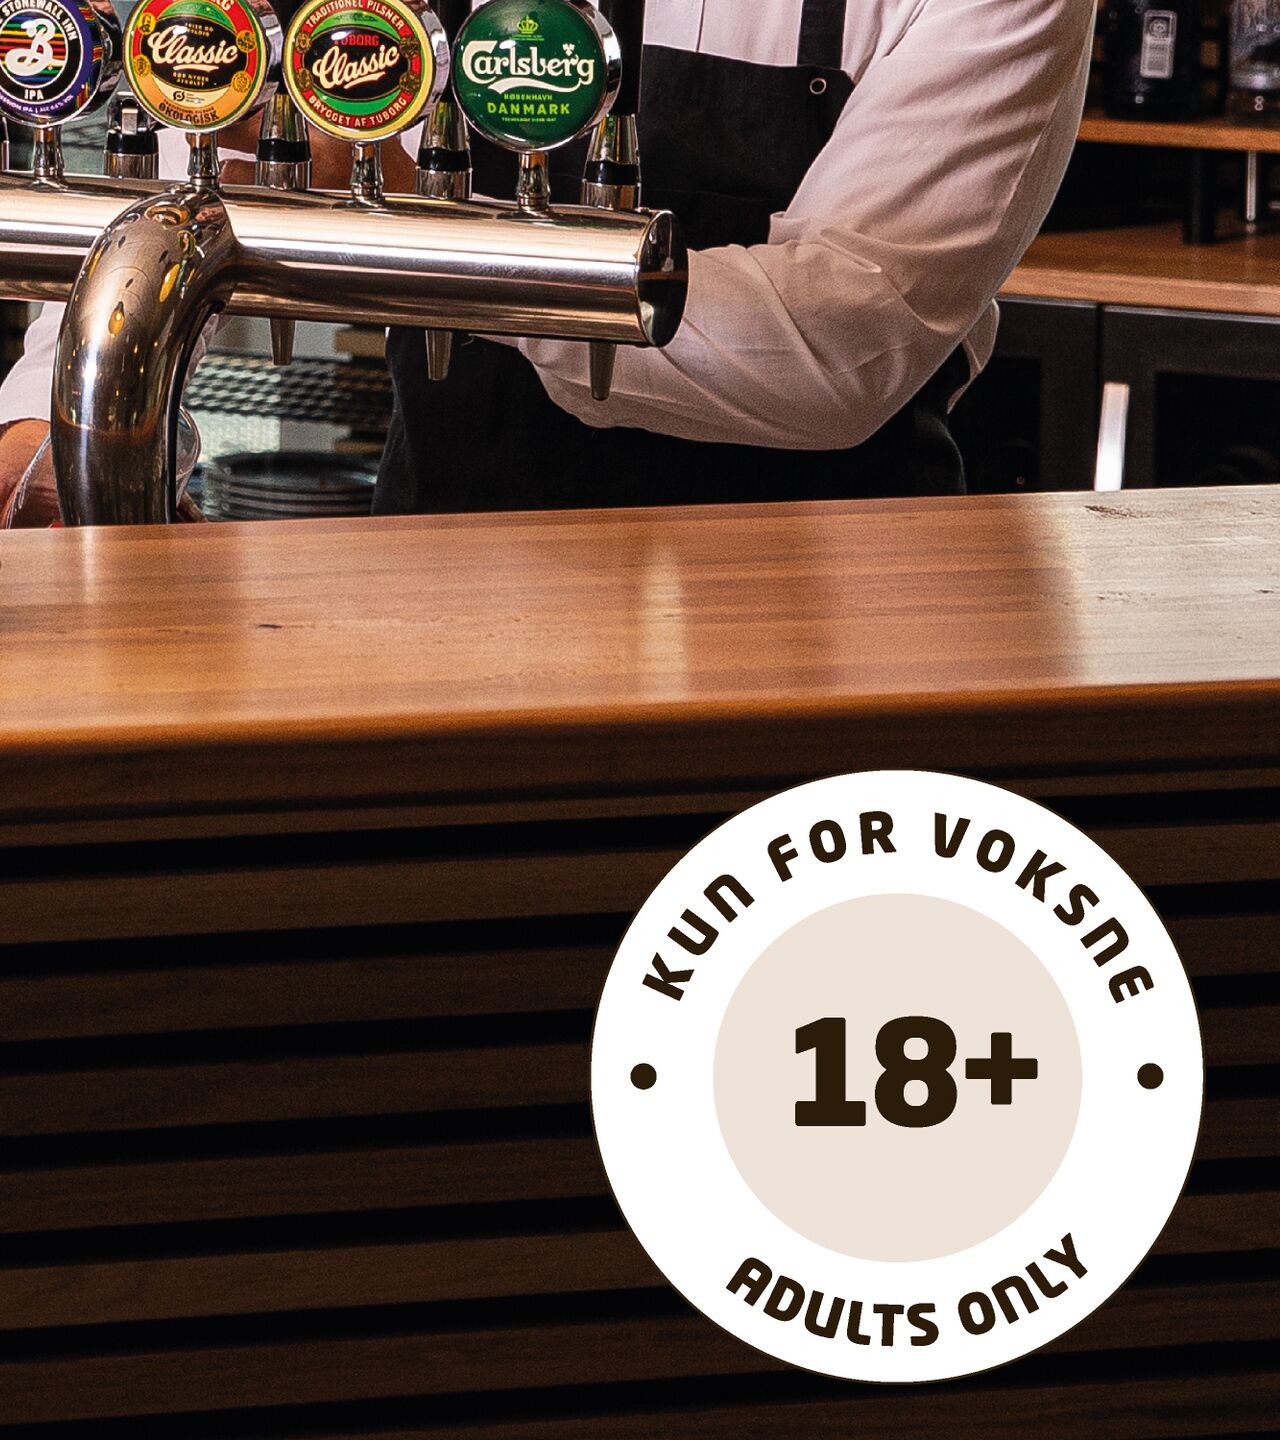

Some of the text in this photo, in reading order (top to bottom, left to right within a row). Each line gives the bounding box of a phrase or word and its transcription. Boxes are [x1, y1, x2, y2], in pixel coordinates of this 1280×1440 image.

[61, 19, 78, 41] INN
[367, 0, 404, 30] PILSNER
[147, 25, 238, 65] Classic
[312, 44, 400, 89] Classic
[462, 40, 595, 94] Carlsberg
[24, 89, 44, 101] IPA
[487, 102, 570, 115] DANMARK
[308, 95, 407, 127] BRYGGET AF TUBORG
